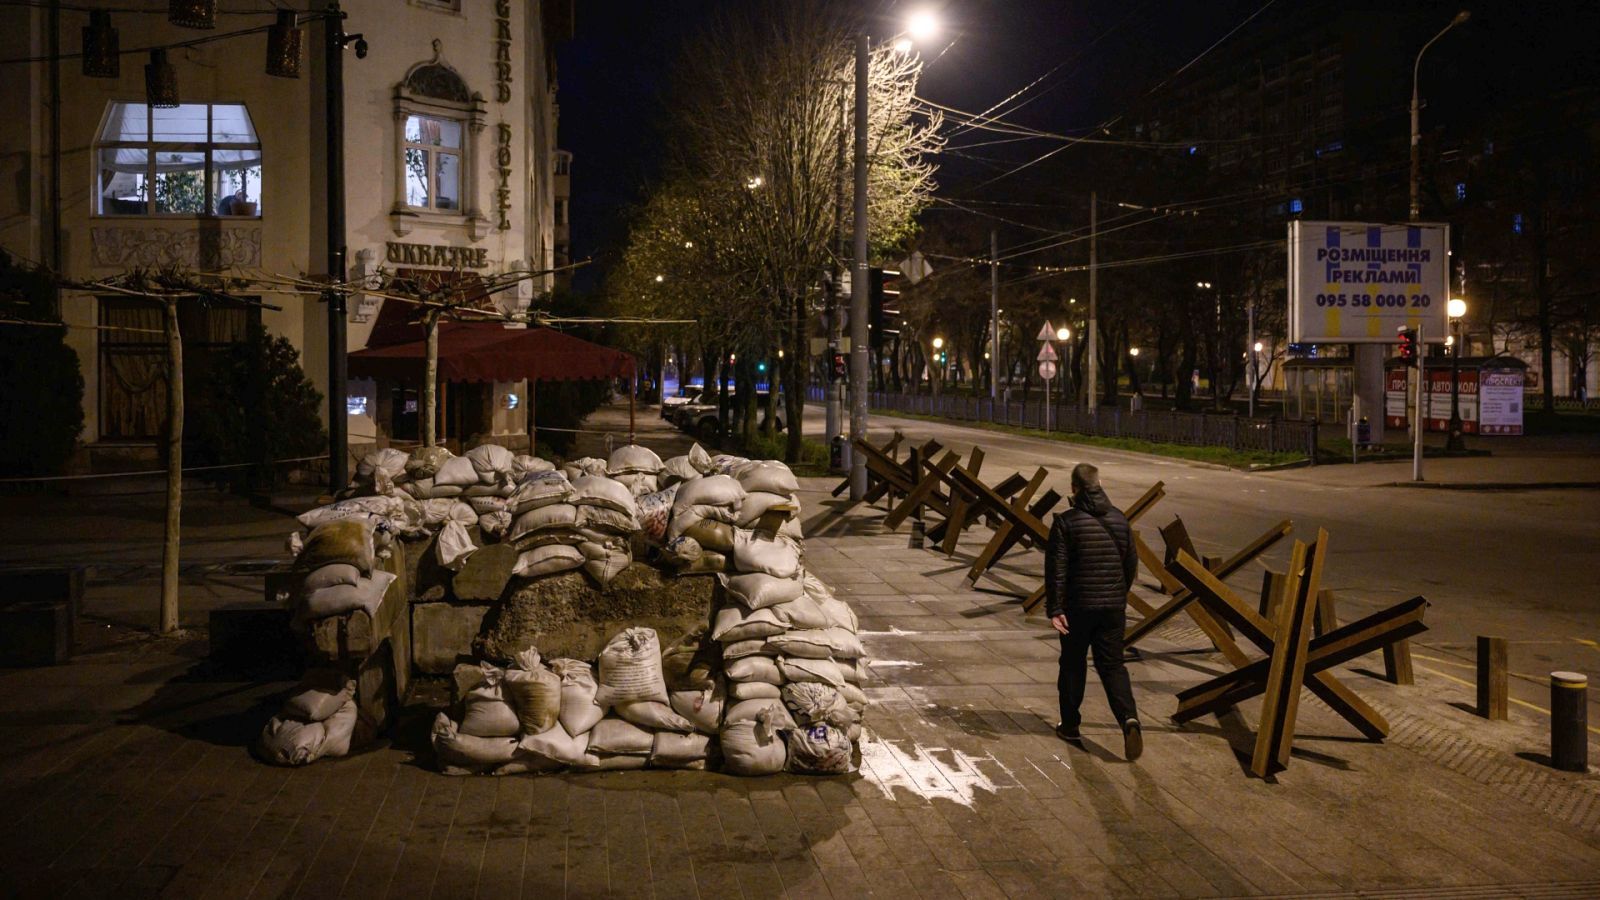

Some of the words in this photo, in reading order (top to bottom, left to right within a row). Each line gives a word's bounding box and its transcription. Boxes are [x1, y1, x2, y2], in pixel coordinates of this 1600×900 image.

[495, 0, 512, 103] GRAND
[497, 123, 511, 230] HOTEL
[386, 241, 488, 268] UKRAINE
[1317, 248, 1431, 264] РОЗМІЩЕННЯ
[1332, 270, 1417, 284] РЕКЛАМИ
[1316, 294, 1347, 307] 095
[1351, 294, 1371, 307] 58
[1375, 294, 1407, 307] 000
[1411, 294, 1431, 307] 20
[1431, 380, 1478, 393] АВТОКОЛА
